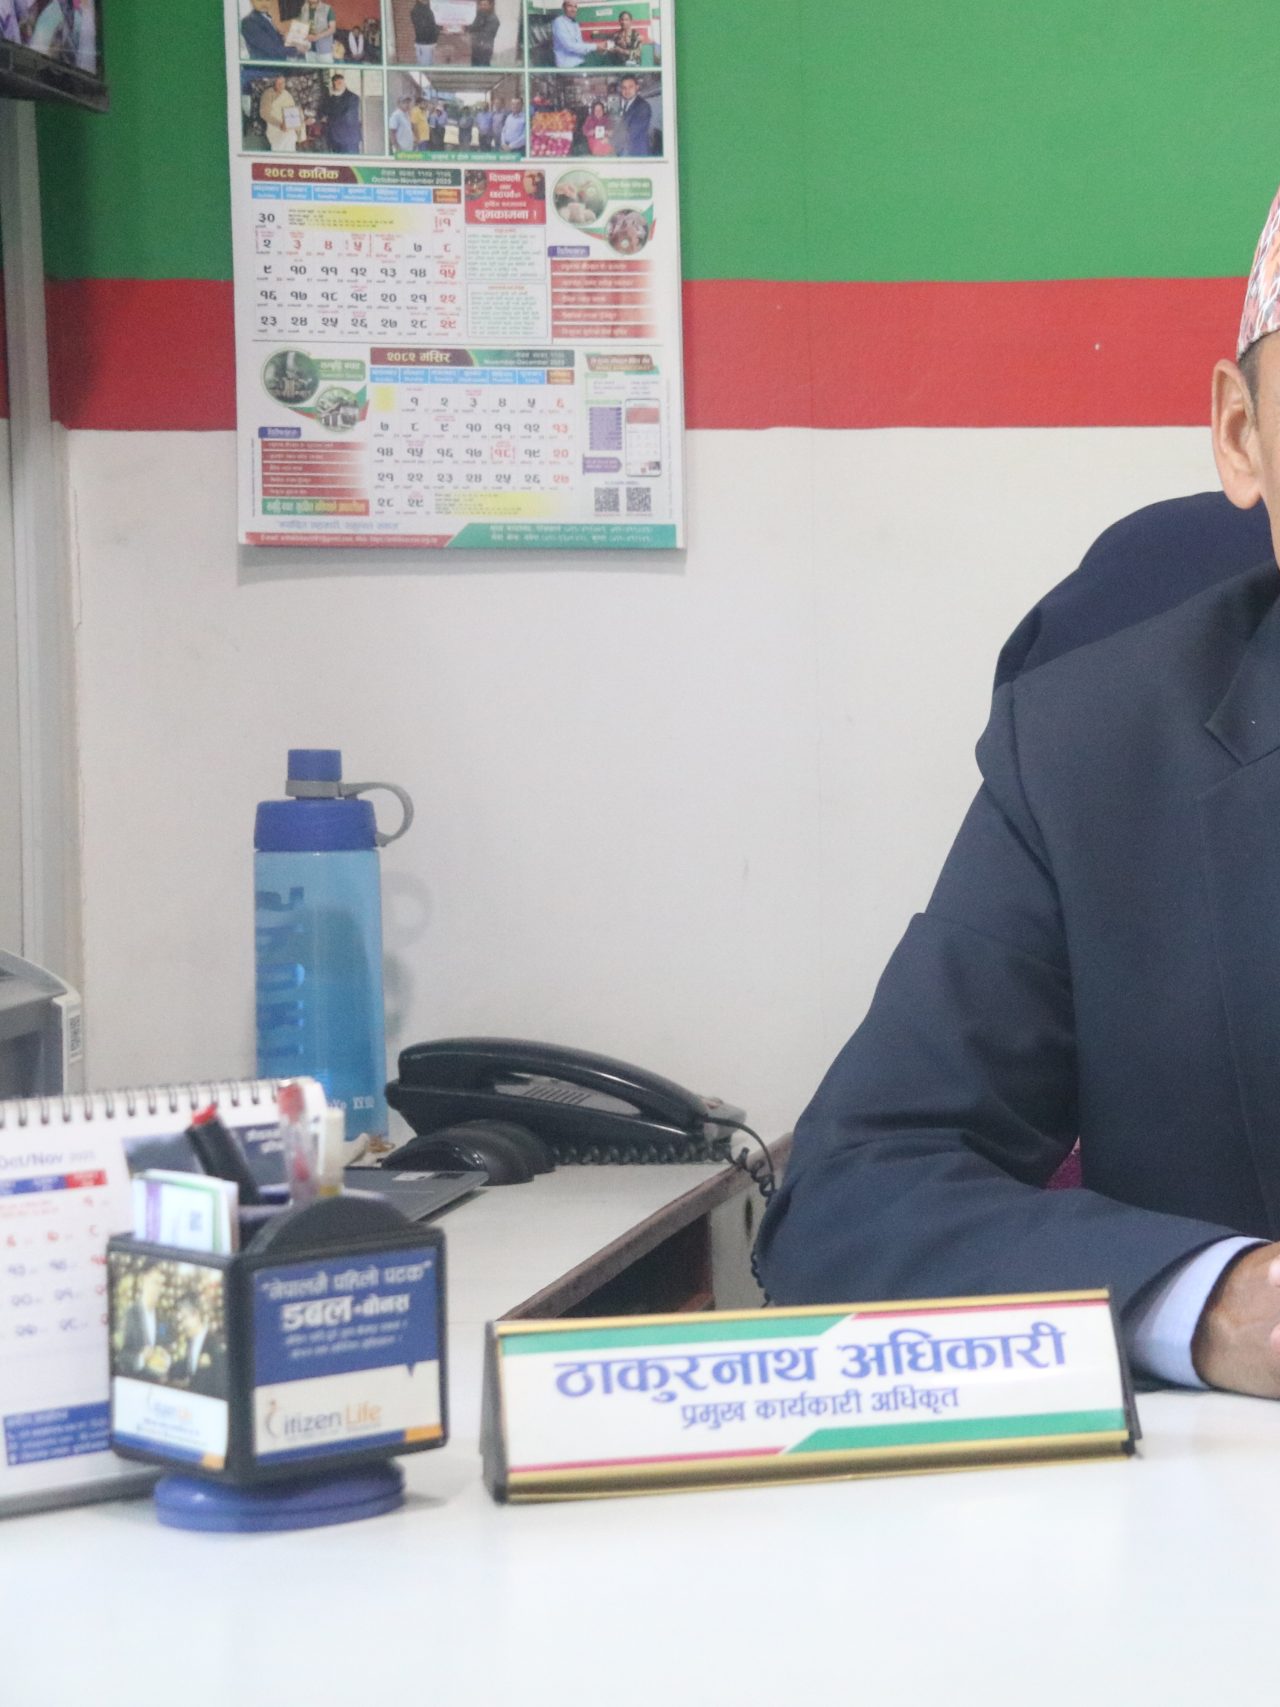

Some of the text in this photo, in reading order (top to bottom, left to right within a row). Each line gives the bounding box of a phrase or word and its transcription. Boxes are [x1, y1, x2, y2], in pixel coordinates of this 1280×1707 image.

[554, 1321, 1066, 1404] ठाकुरनाथ अधिकारी
[345, 1400, 382, 1425] Life
[681, 1384, 960, 1430] प्रमुख कार्यकारी अधिकृत
